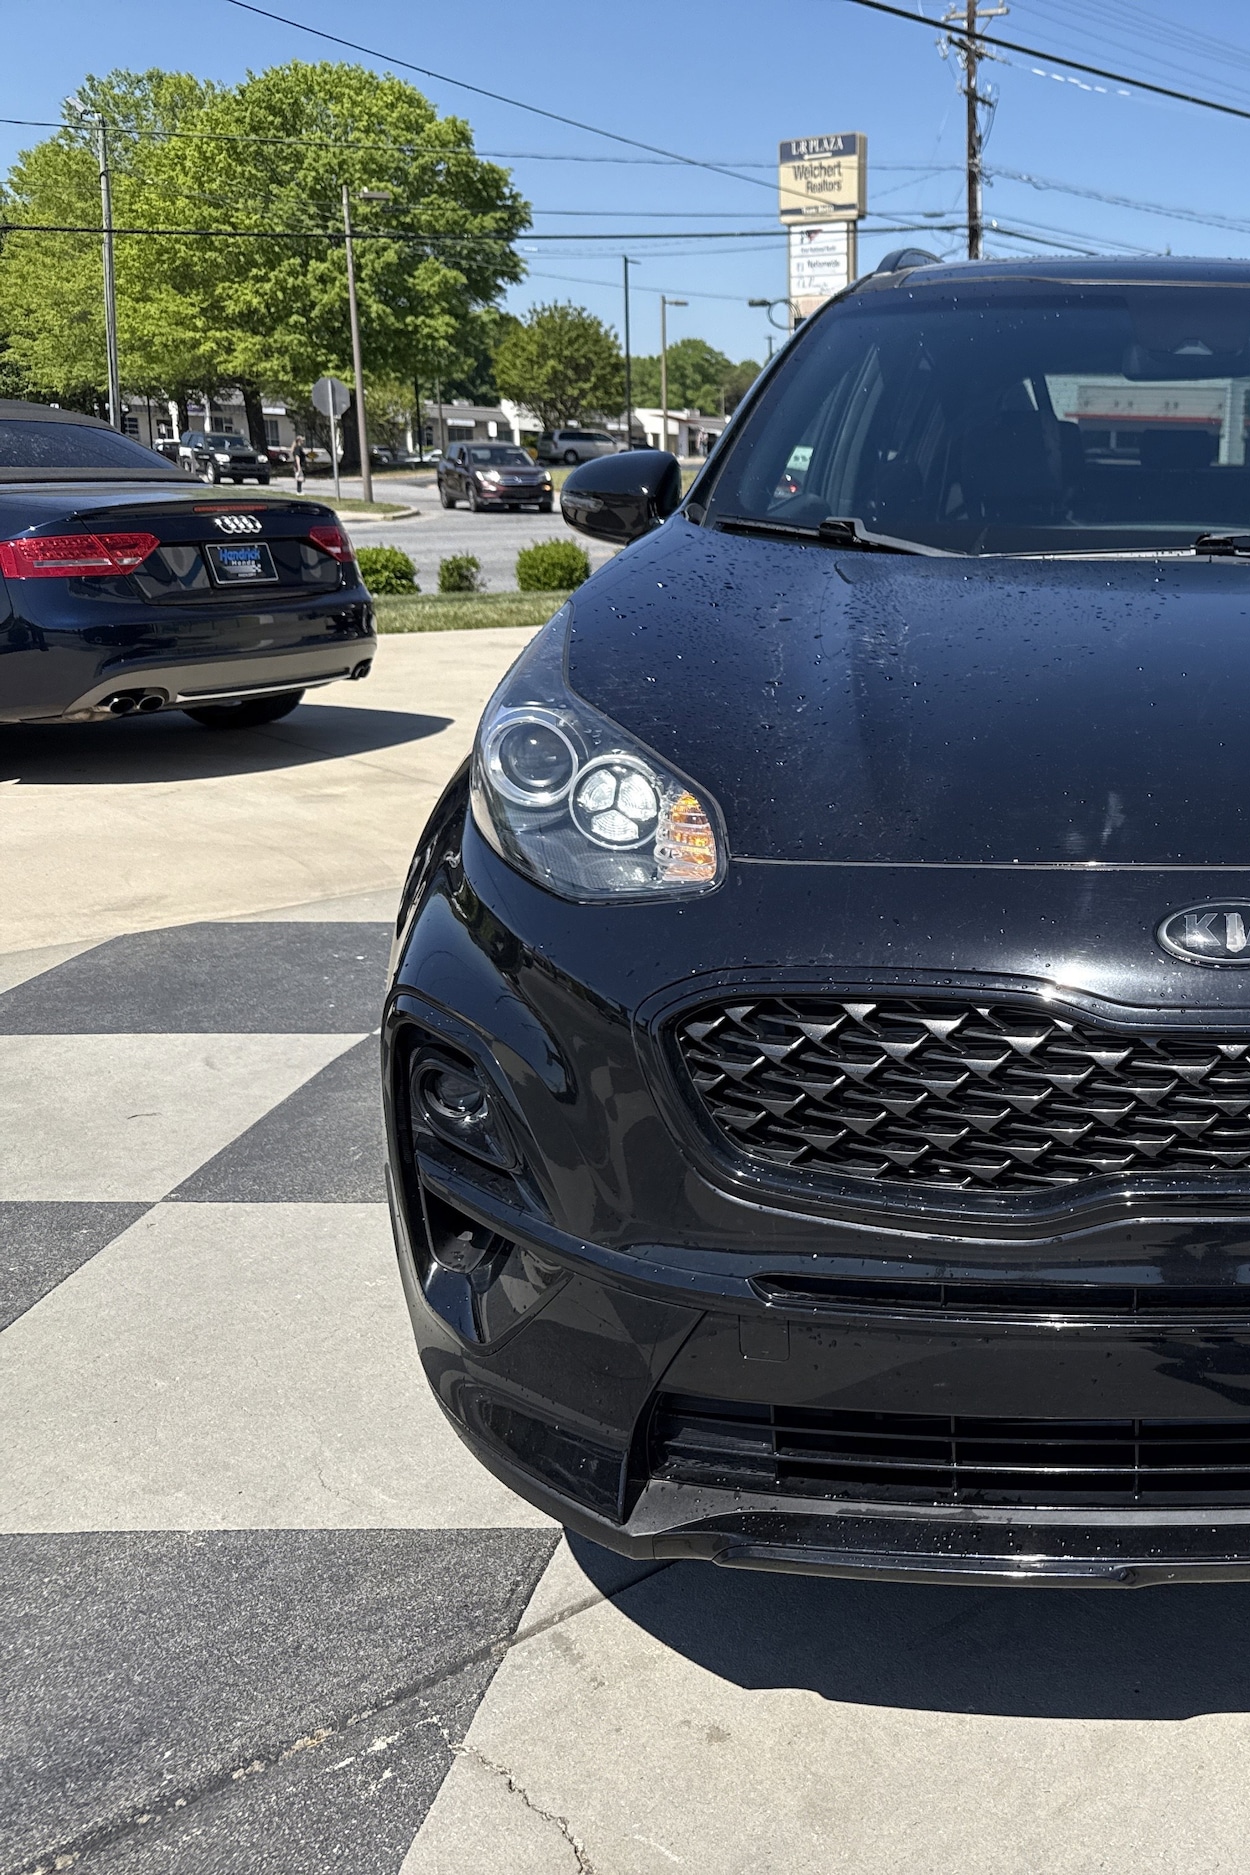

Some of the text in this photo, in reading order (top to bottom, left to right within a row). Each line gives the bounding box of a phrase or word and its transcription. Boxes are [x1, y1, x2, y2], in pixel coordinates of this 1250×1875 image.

[809, 136, 844, 153] PLAZA
[806, 180, 842, 194] Realtors
[219, 549, 260, 564] Hendrick
